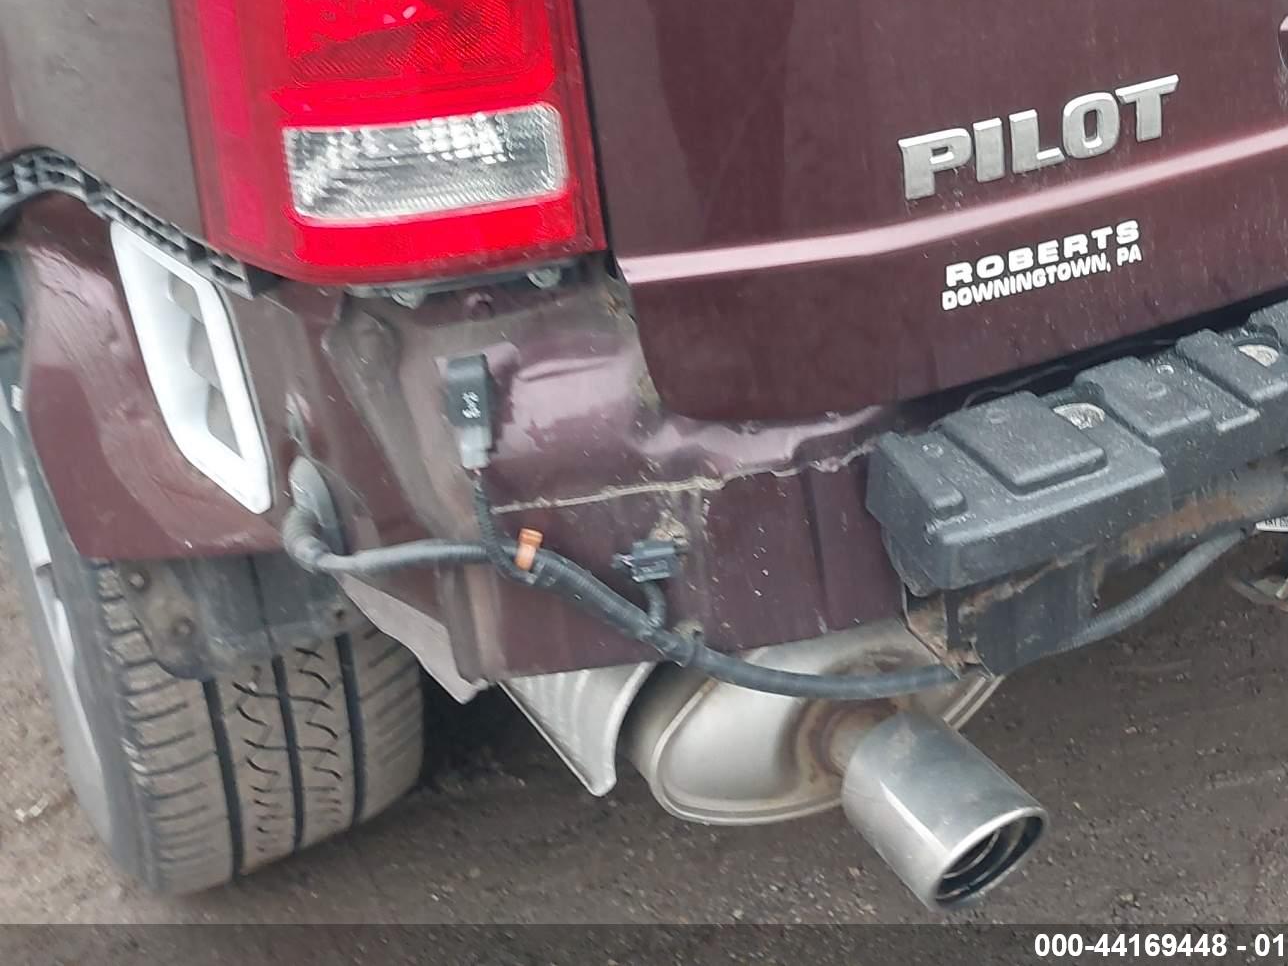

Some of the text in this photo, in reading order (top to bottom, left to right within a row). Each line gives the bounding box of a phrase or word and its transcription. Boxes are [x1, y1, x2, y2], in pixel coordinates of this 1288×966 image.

[898, 74, 1179, 200] PILOT
[942, 244, 1142, 311] DOWNINGTOWN, PA
[946, 220, 1140, 287] ROBERTS
